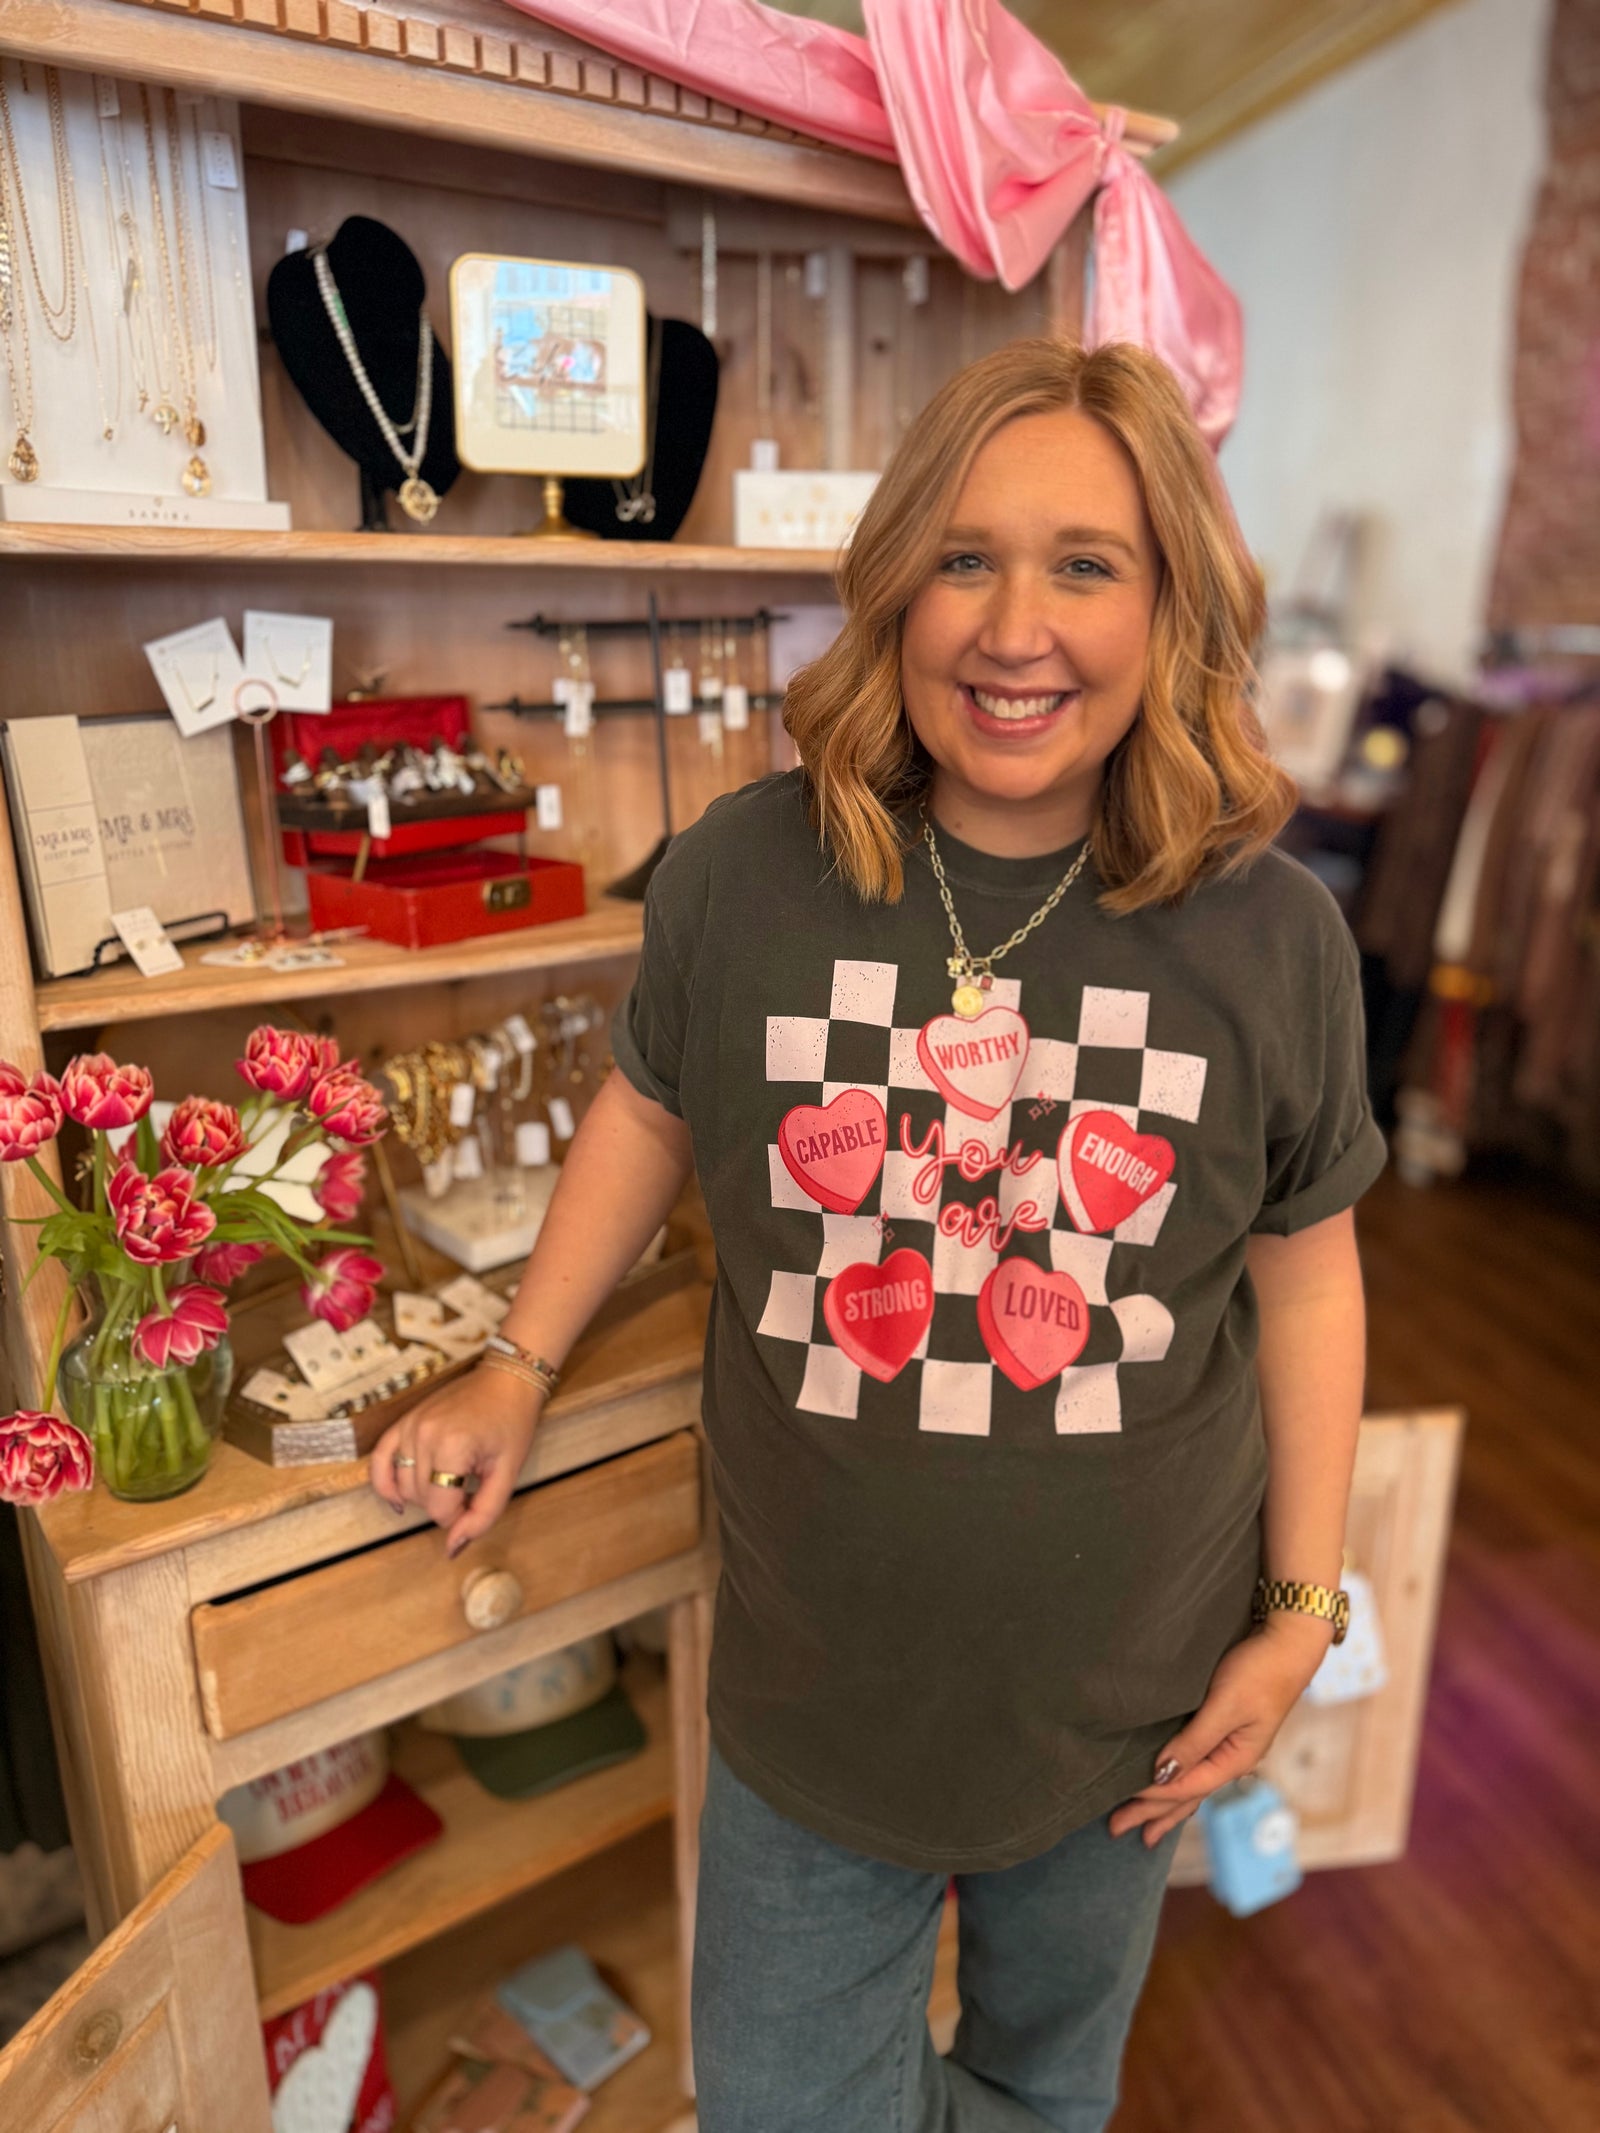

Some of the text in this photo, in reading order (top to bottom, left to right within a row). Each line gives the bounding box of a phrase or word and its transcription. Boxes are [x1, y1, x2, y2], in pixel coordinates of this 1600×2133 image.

[99, 815, 134, 845] MR
[934, 1031, 1019, 1070] WORTHY
[796, 1118, 882, 1165] CAPABLE
[900, 1112, 1043, 1205] you
[1077, 1131, 1159, 1196] ENOUGH
[939, 1195, 1048, 1253] are
[844, 1278, 927, 1323] STRONG
[1004, 1282, 1080, 1332] LOVED
